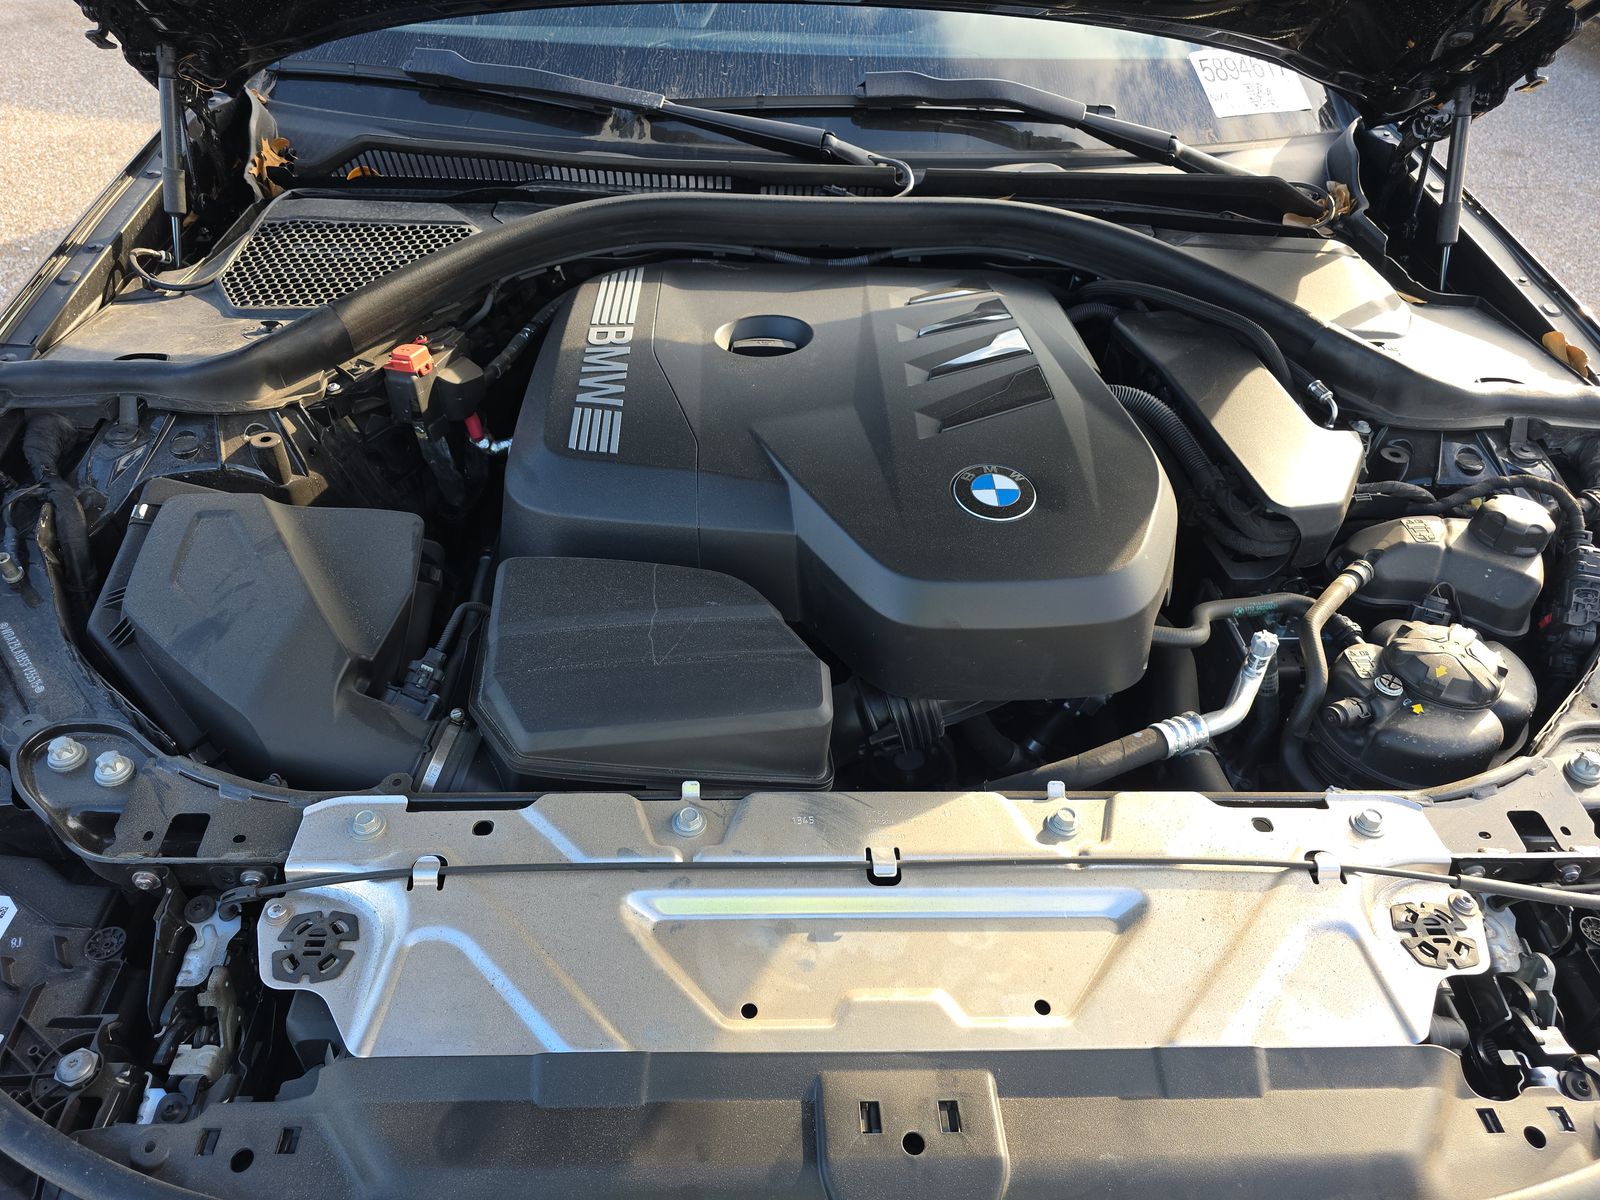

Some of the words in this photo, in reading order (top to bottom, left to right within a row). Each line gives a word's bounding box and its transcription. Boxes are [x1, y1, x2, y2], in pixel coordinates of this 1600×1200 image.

[576, 326, 634, 407] BMW
[961, 464, 1025, 482] BMW
[792, 815, 815, 825] 1345
